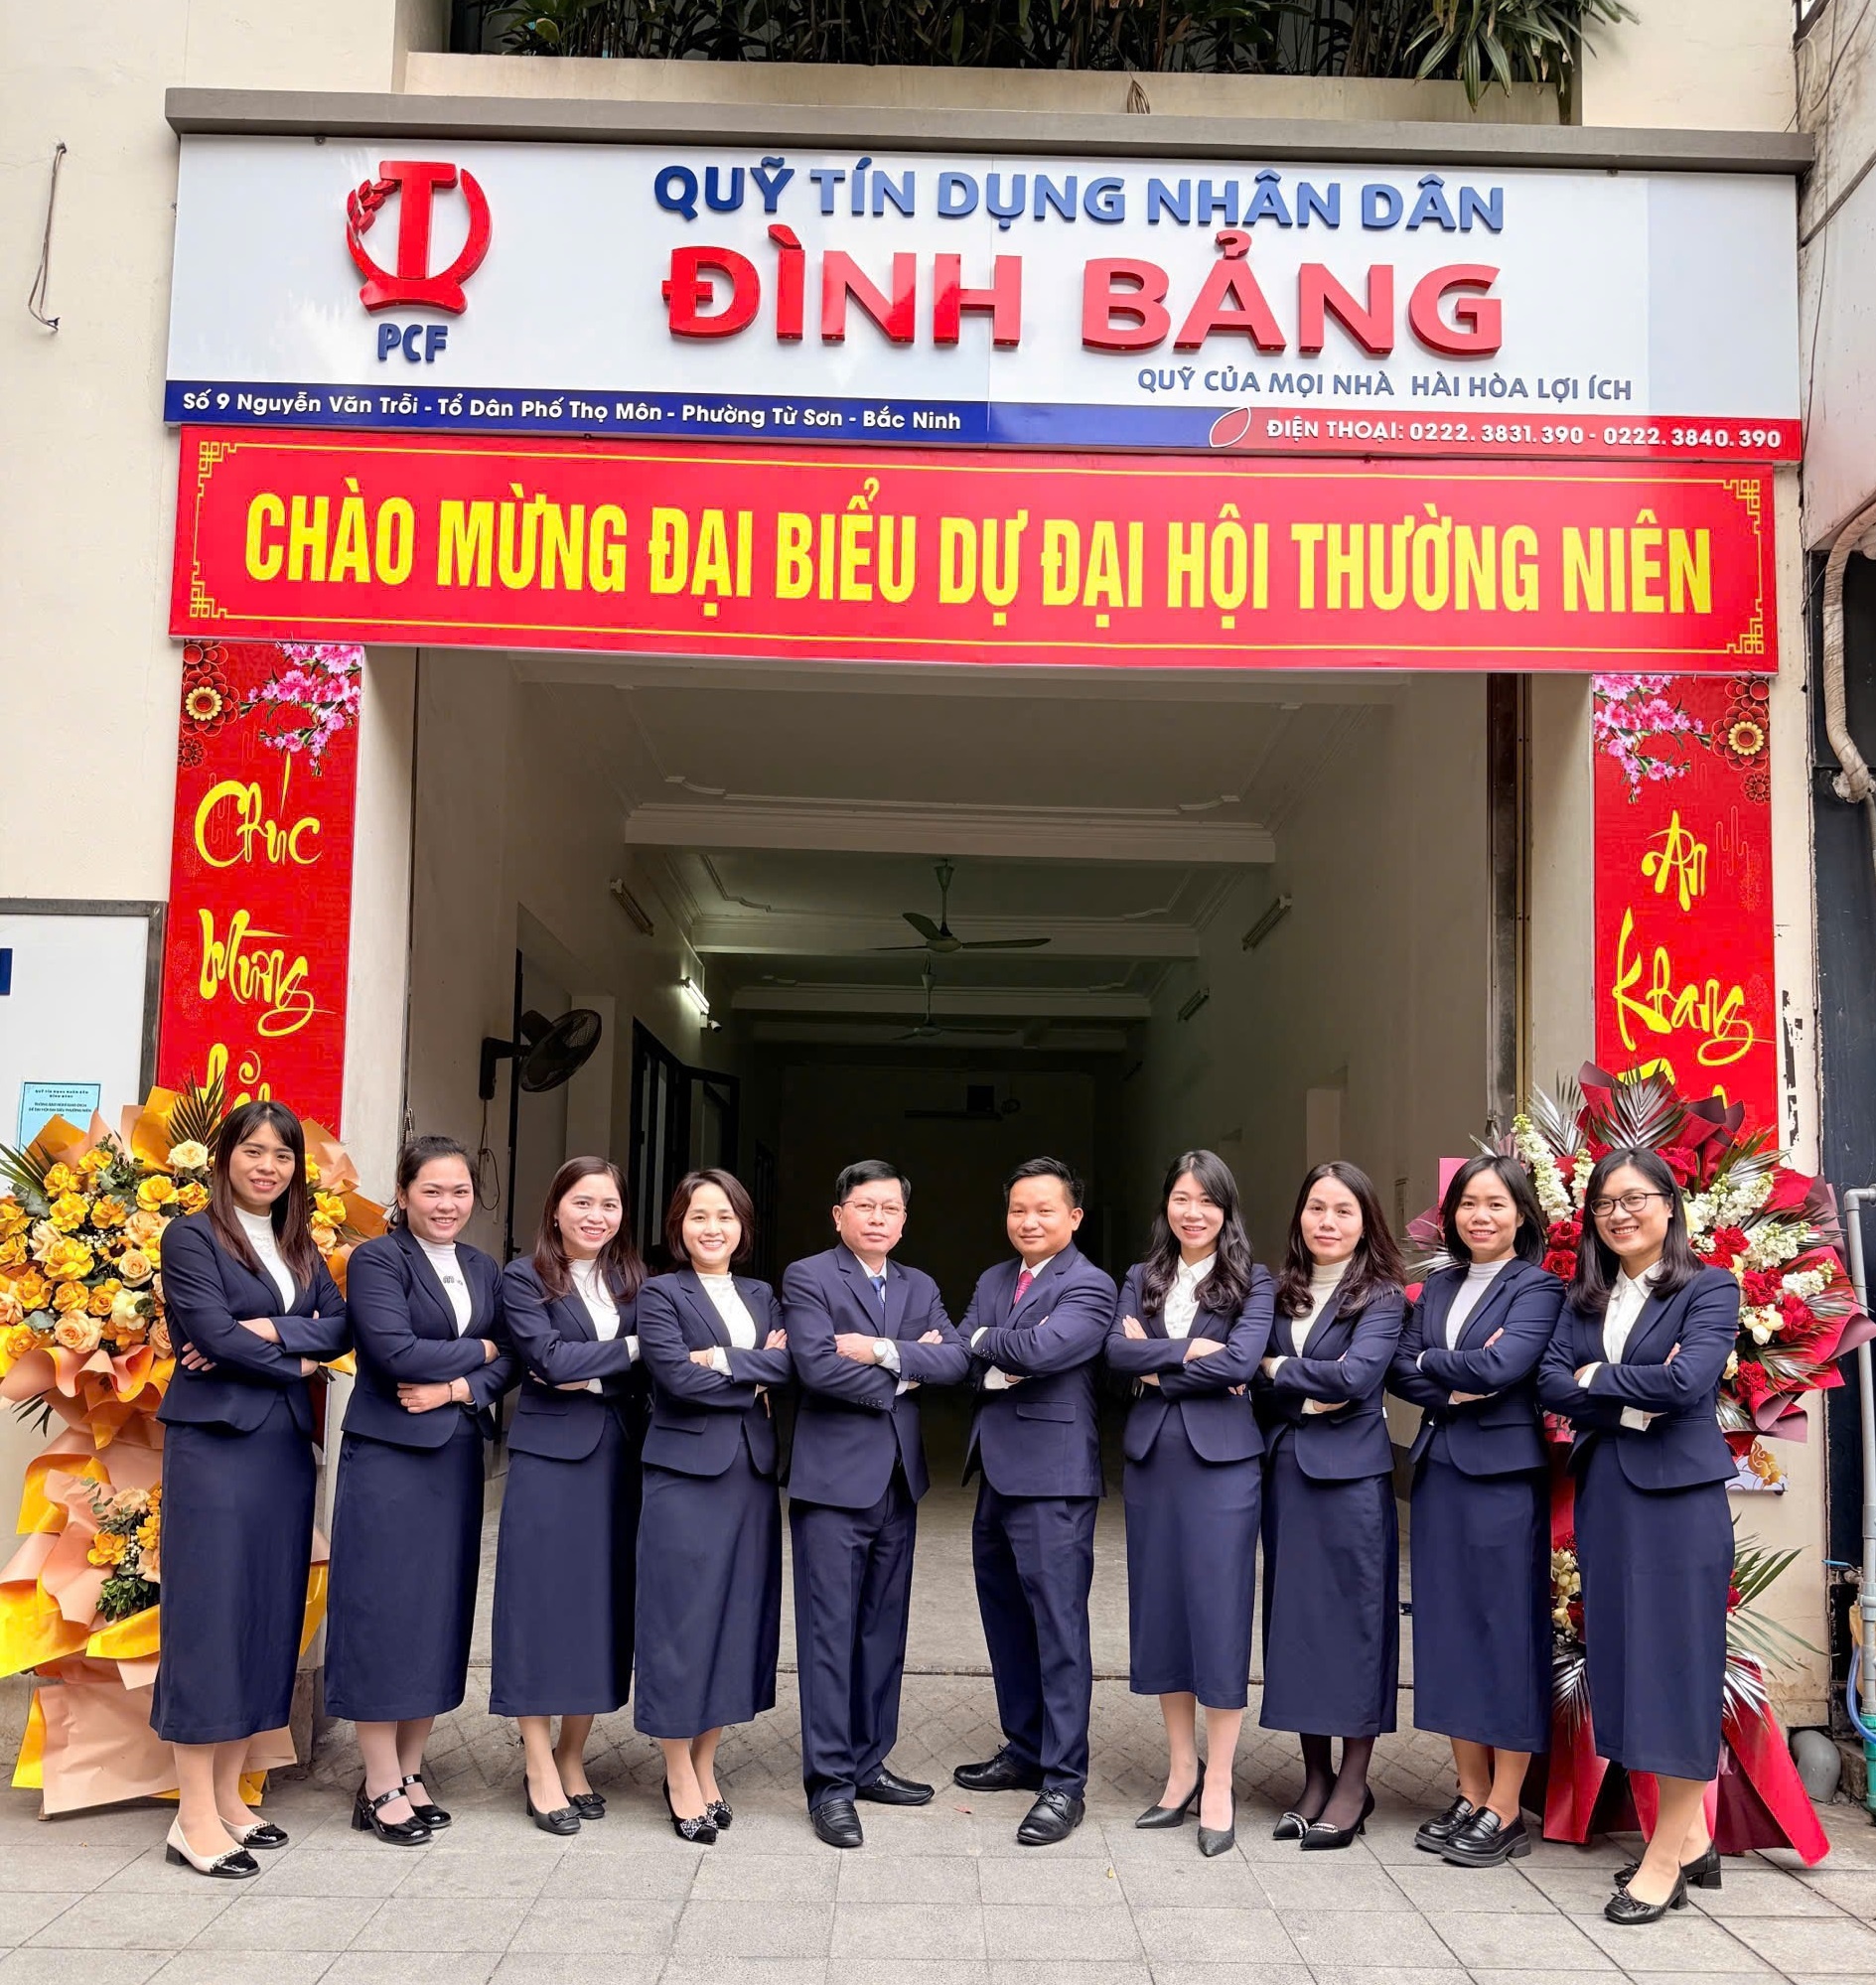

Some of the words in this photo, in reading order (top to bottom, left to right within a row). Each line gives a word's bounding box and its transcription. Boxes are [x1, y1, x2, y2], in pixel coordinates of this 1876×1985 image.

[654, 156, 794, 221] QUỸ
[810, 156, 916, 217] TÍN
[938, 171, 1126, 231] DỤNG
[1147, 169, 1341, 229] NHÂN
[1361, 173, 1504, 233] DÂN
[661, 223, 1023, 348] ĐÌNH
[1082, 229, 1503, 358] BẢNG
[377, 323, 448, 362] PCF
[1137, 366, 1195, 392] QUỸ
[1204, 365, 1260, 392] CỦA
[1269, 372, 1324, 397] MỌI
[1333, 370, 1394, 395] NHÀ
[1412, 371, 1460, 396] HÀI
[1469, 372, 1528, 398] HÒA
[1537, 377, 1578, 403] LỢI
[1588, 374, 1632, 400] ÍCH
[183, 388, 212, 410] Số
[216, 393, 230, 410] 9
[236, 391, 321, 416] Nguyễn
[329, 395, 372, 413] Văn
[379, 392, 418, 415] Trỗi
[437, 392, 464, 417] Tổ
[470, 398, 513, 417] Dân
[521, 396, 565, 418] Phố
[569, 400, 608, 422] Thọ
[616, 403, 662, 421] Môn
[682, 403, 766, 428] Phường
[772, 405, 799, 426] Từ
[802, 408, 843, 427] Sơn
[863, 405, 906, 428] Bắc
[913, 411, 960, 430] Ninh
[1266, 415, 1319, 442] ĐIỆN
[1326, 420, 1404, 443] THOẠI:
[245, 477, 415, 585] CHÀO
[437, 483, 628, 593] MỪNG
[648, 506, 753, 617] ĐẠI
[776, 477, 917, 604] BIỂU
[938, 508, 1029, 626] DỰ
[1040, 519, 1144, 628] ĐẠI
[1167, 502, 1269, 629] HỘI
[1290, 503, 1540, 612] THƯỜNG
[1562, 508, 1712, 614] NIÊN
[194, 752, 323, 868] Chúc
[1641, 809, 1708, 912] An
[198, 908, 334, 1037] Mừng
[1612, 906, 1772, 1066] Khang
